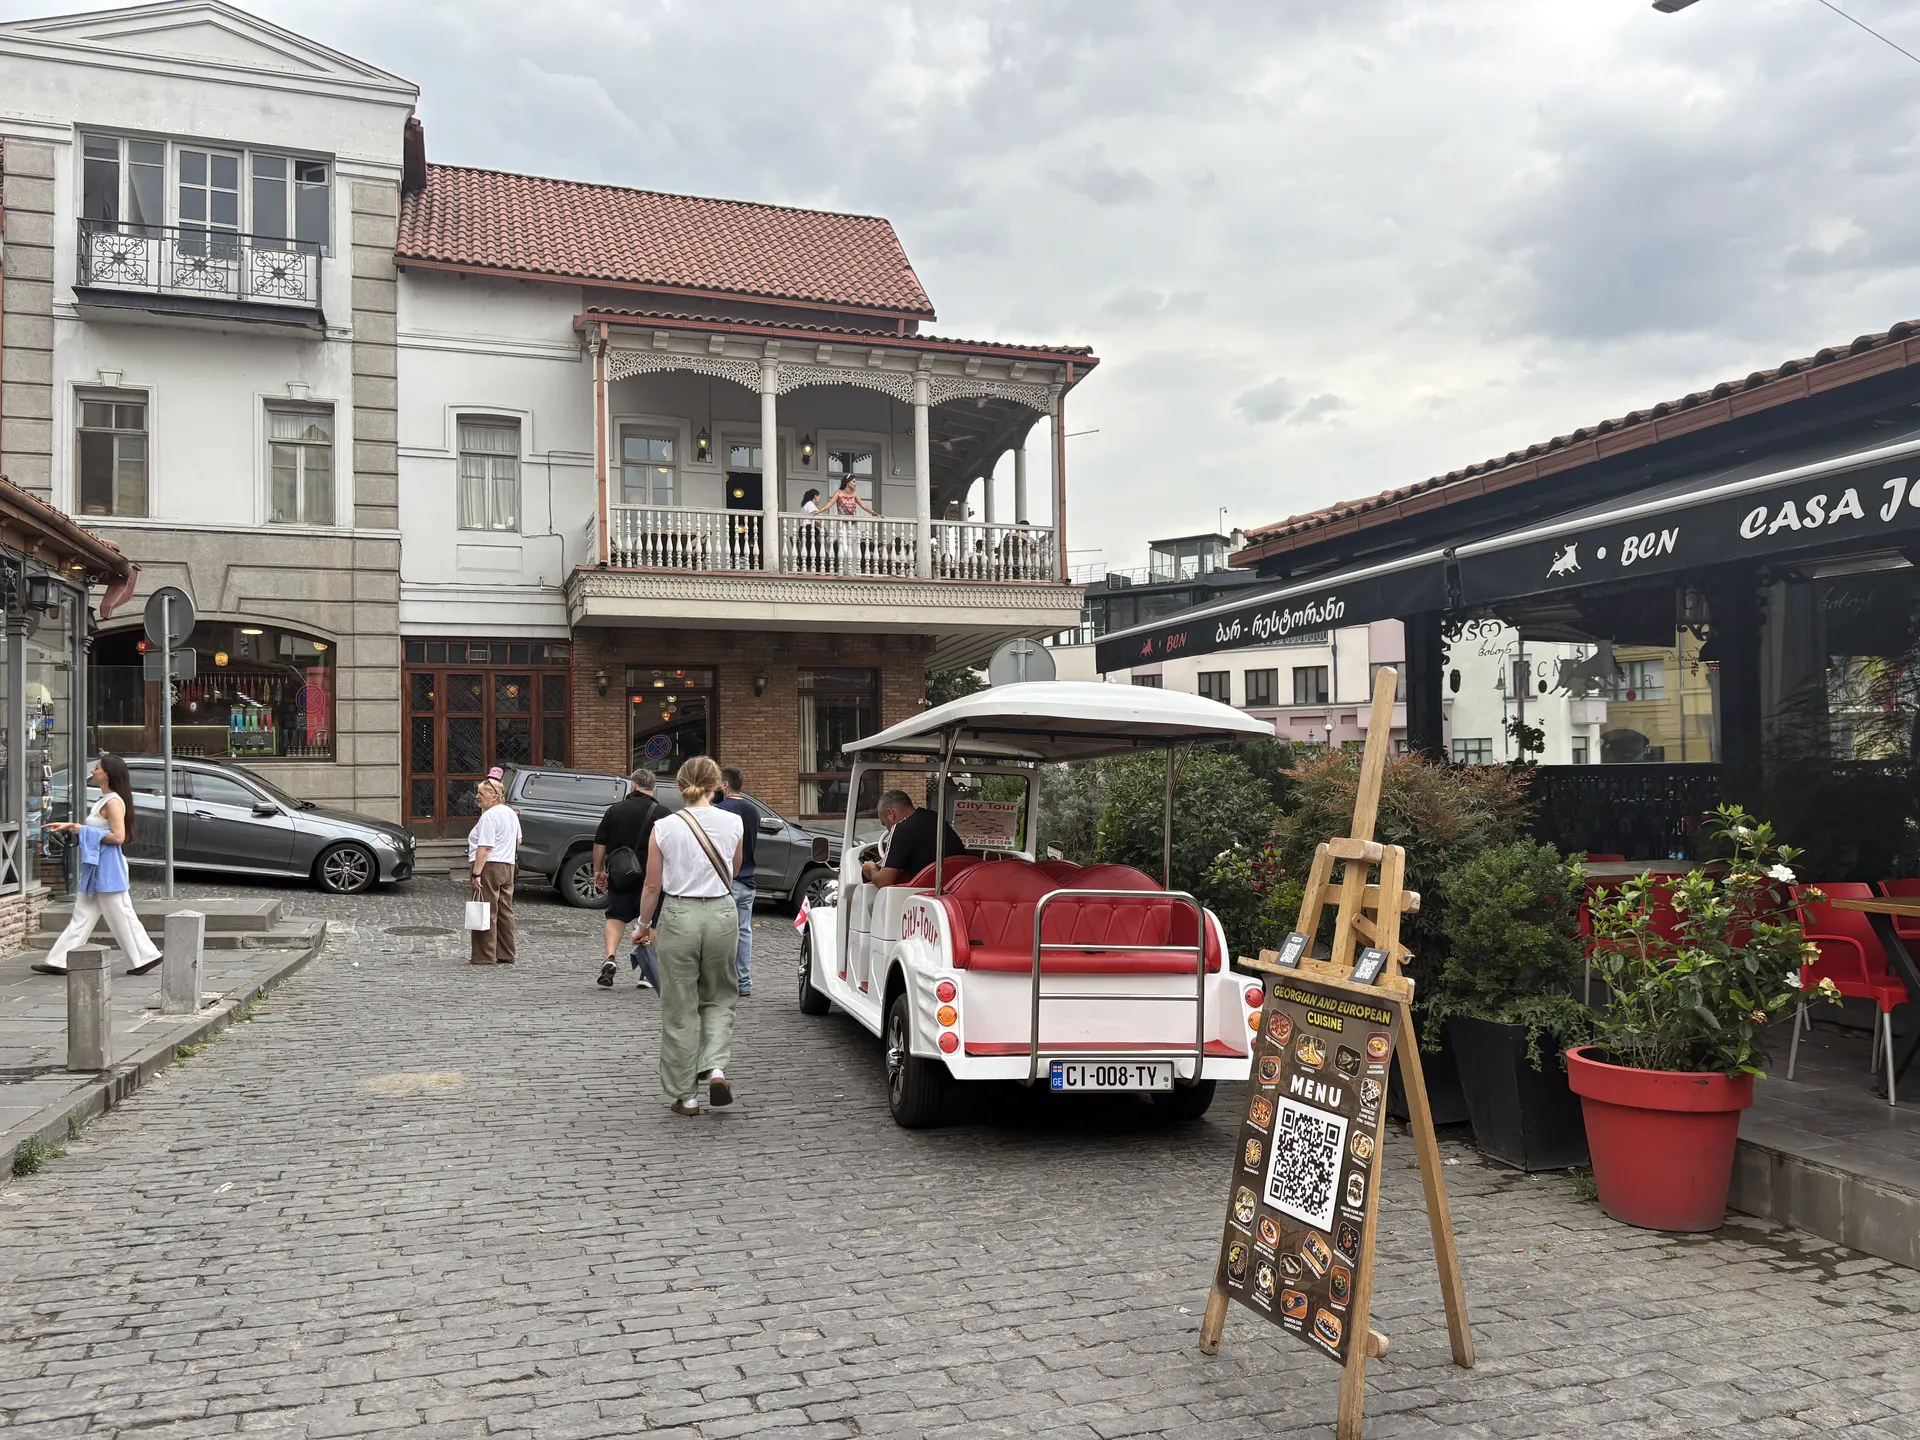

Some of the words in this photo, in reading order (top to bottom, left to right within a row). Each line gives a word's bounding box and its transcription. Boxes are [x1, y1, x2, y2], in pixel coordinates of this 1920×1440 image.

[1740, 488, 1866, 540] CASA
[1620, 527, 1680, 566] BCN
[1215, 618, 1241, 643] ბარ
[1252, 596, 1346, 639] რესტორანი
[1166, 632, 1188, 653] BCN
[956, 801, 983, 811] City
[986, 802, 1017, 811] Tour
[1273, 985, 1317, 1006] GEORGIAN
[1316, 997, 1338, 1012] AND
[1338, 1003, 1392, 1025] EUROPEAN
[1306, 1011, 1343, 1031] CUISINE
[1052, 1078, 1062, 1086] GE
[1066, 1066, 1157, 1086] CI-008-TY
[1290, 1074, 1342, 1108] MENU
